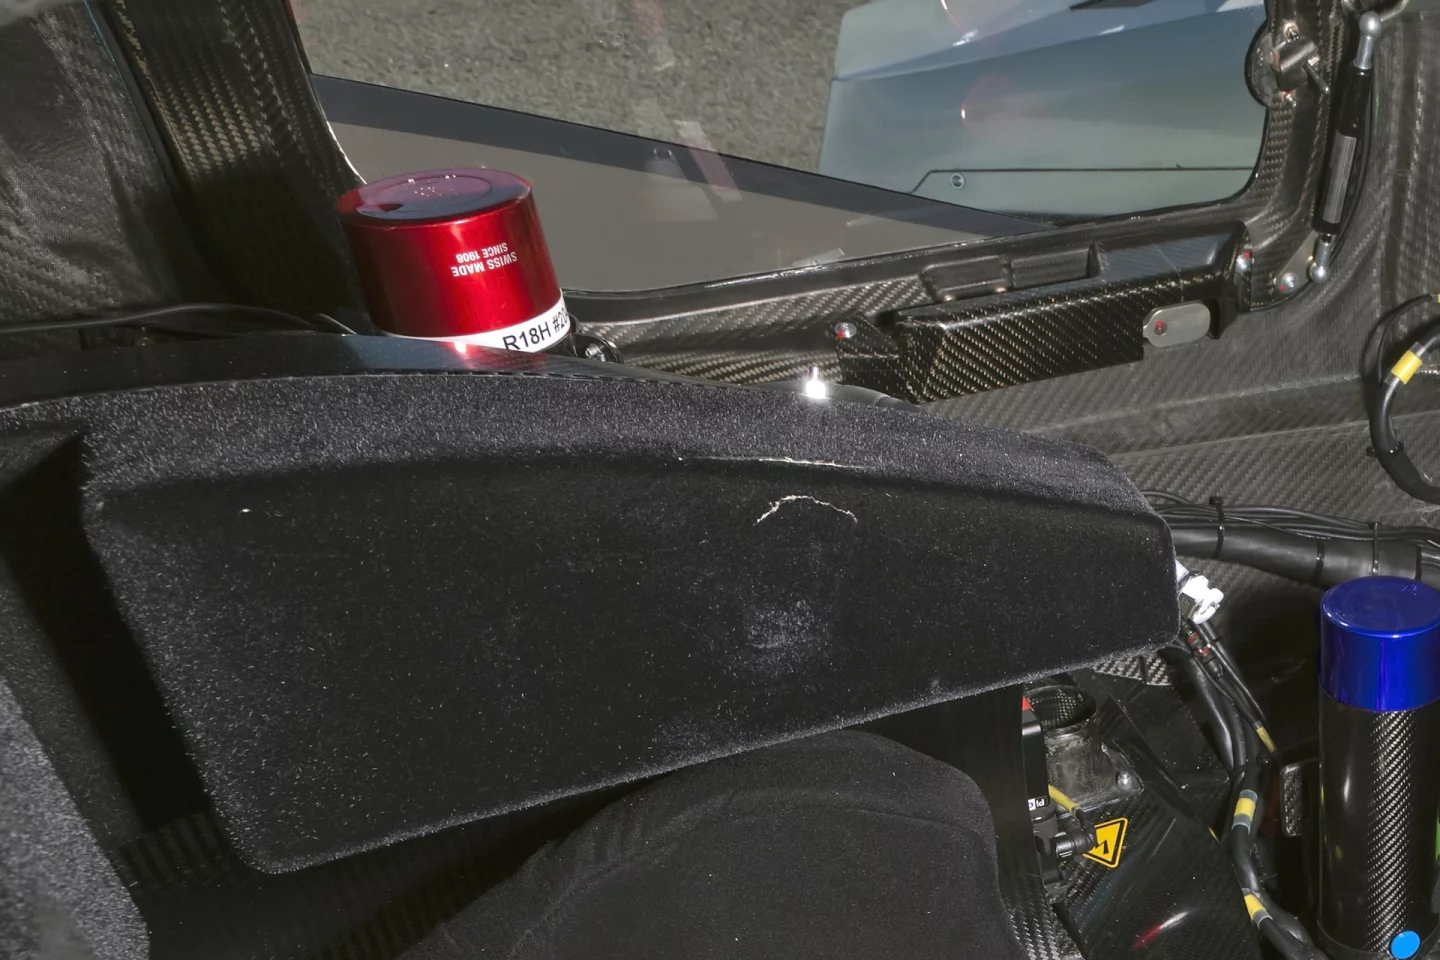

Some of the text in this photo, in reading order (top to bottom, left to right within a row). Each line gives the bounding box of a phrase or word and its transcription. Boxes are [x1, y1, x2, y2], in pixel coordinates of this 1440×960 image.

[452, 252, 517, 277] SWISS MADE
[456, 242, 508, 263] SINCE 1908
[502, 321, 552, 350] R18H
